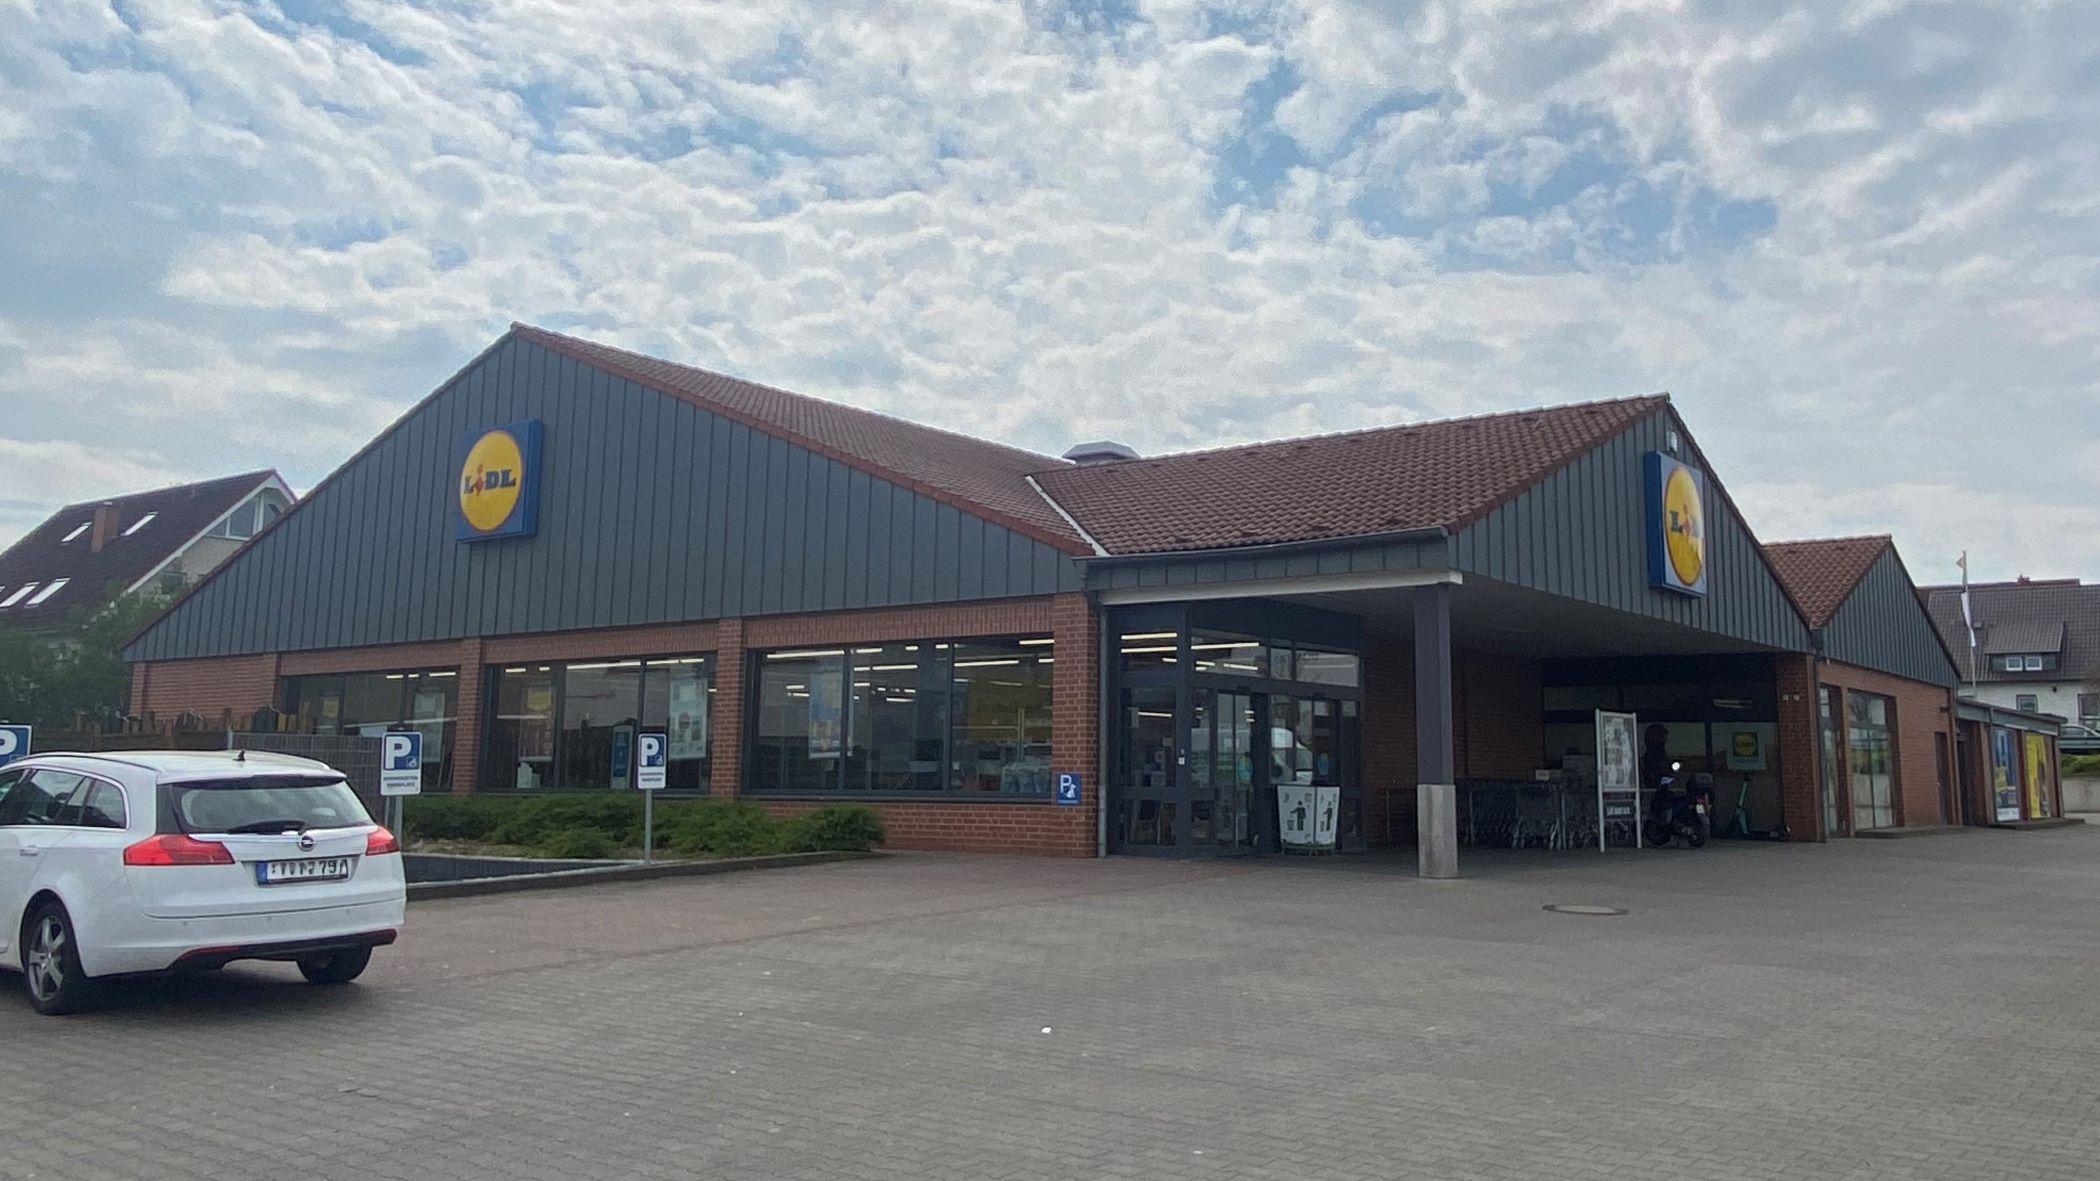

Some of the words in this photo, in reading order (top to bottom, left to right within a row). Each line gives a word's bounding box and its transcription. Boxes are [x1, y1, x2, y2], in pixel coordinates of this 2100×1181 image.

[385, 736, 412, 769] P
[641, 737, 660, 766] P
[1060, 774, 1072, 793] P
